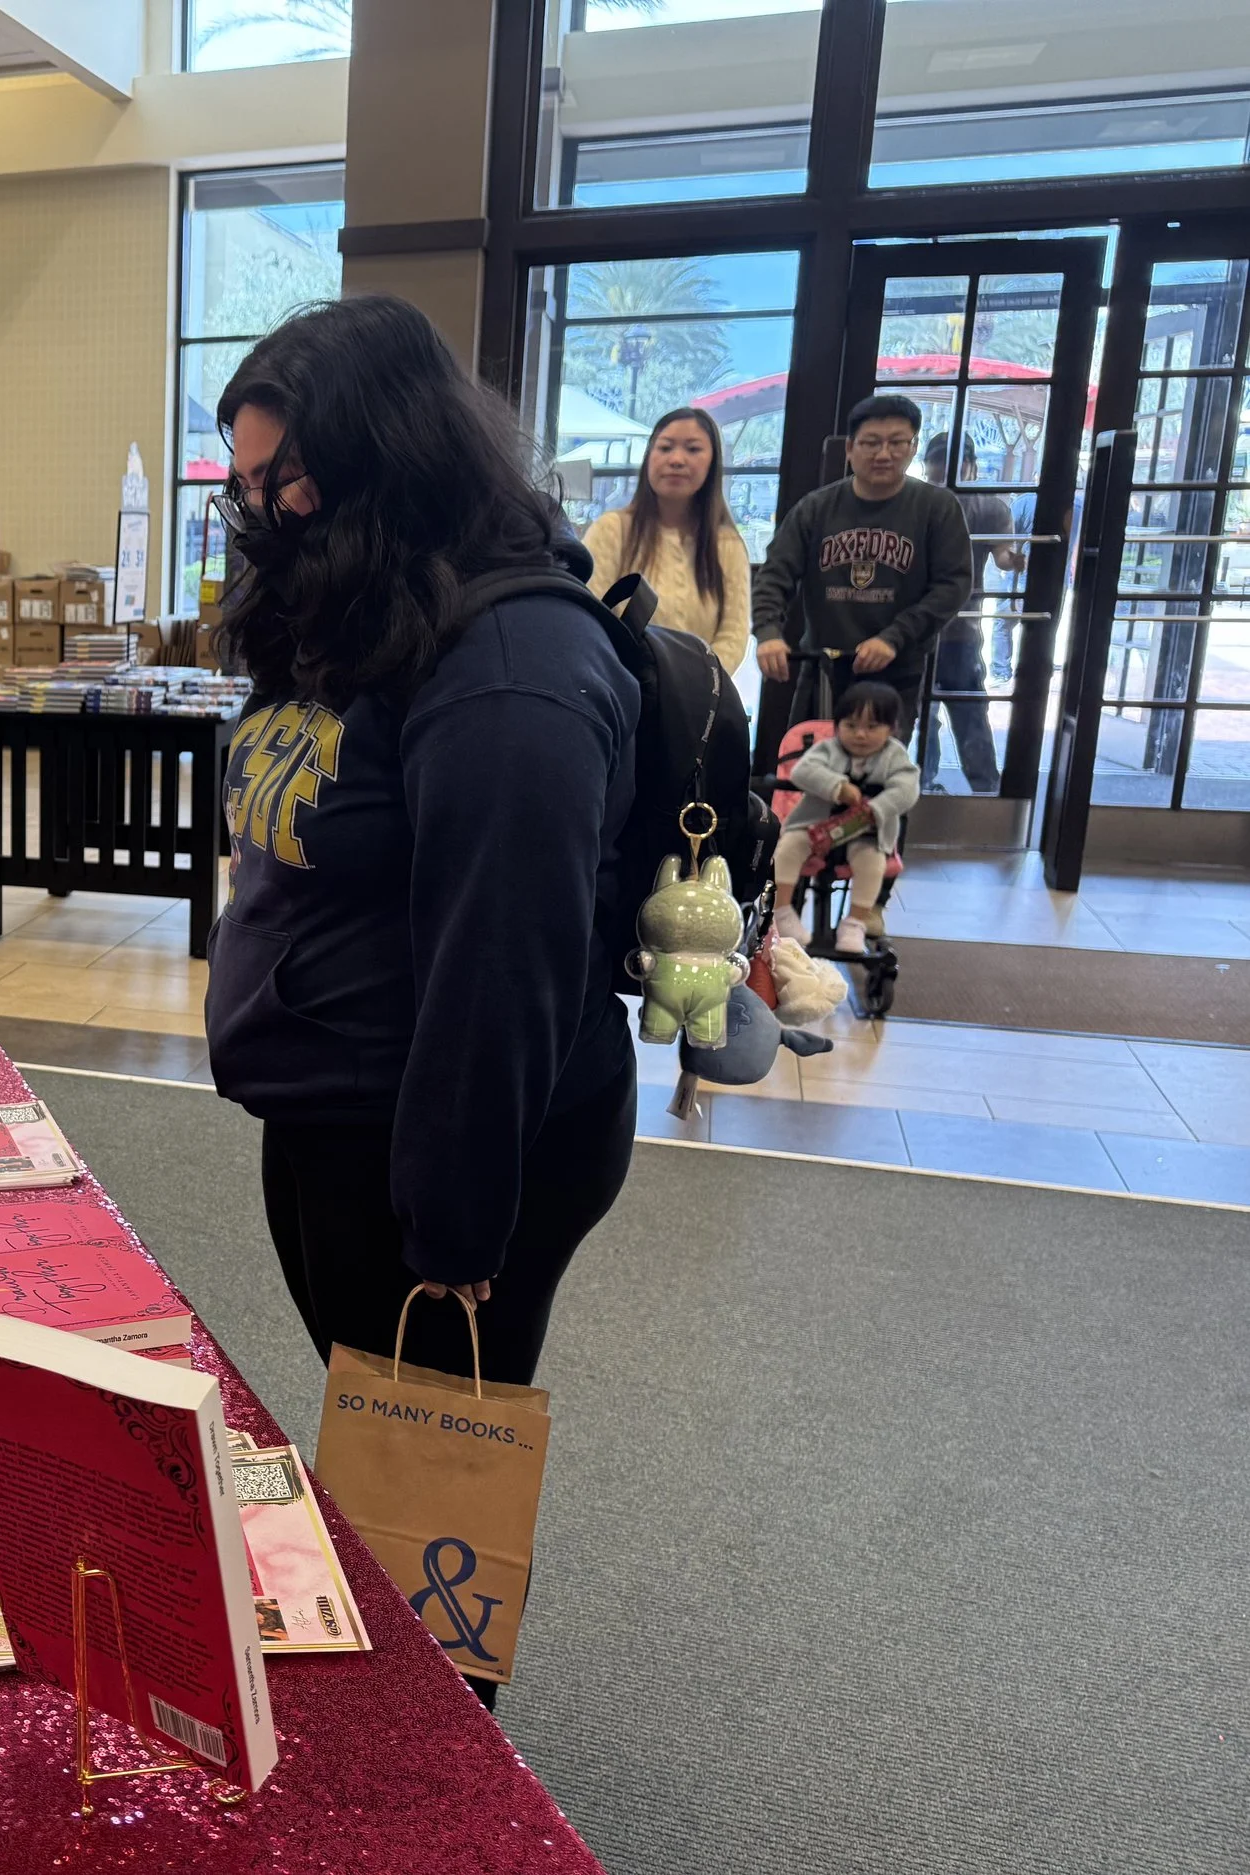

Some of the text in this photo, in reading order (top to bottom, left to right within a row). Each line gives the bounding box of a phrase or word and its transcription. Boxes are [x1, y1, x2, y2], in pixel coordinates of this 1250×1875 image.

[819, 528, 913, 574] OXFORD
[11, 1258, 107, 1315] Together
[123, 1331, 148, 1342] Zamora
[337, 1394, 534, 1452] SO MANY BOOKS...
[214, 1452, 225, 1497] Together
[409, 1537, 503, 1663] &
